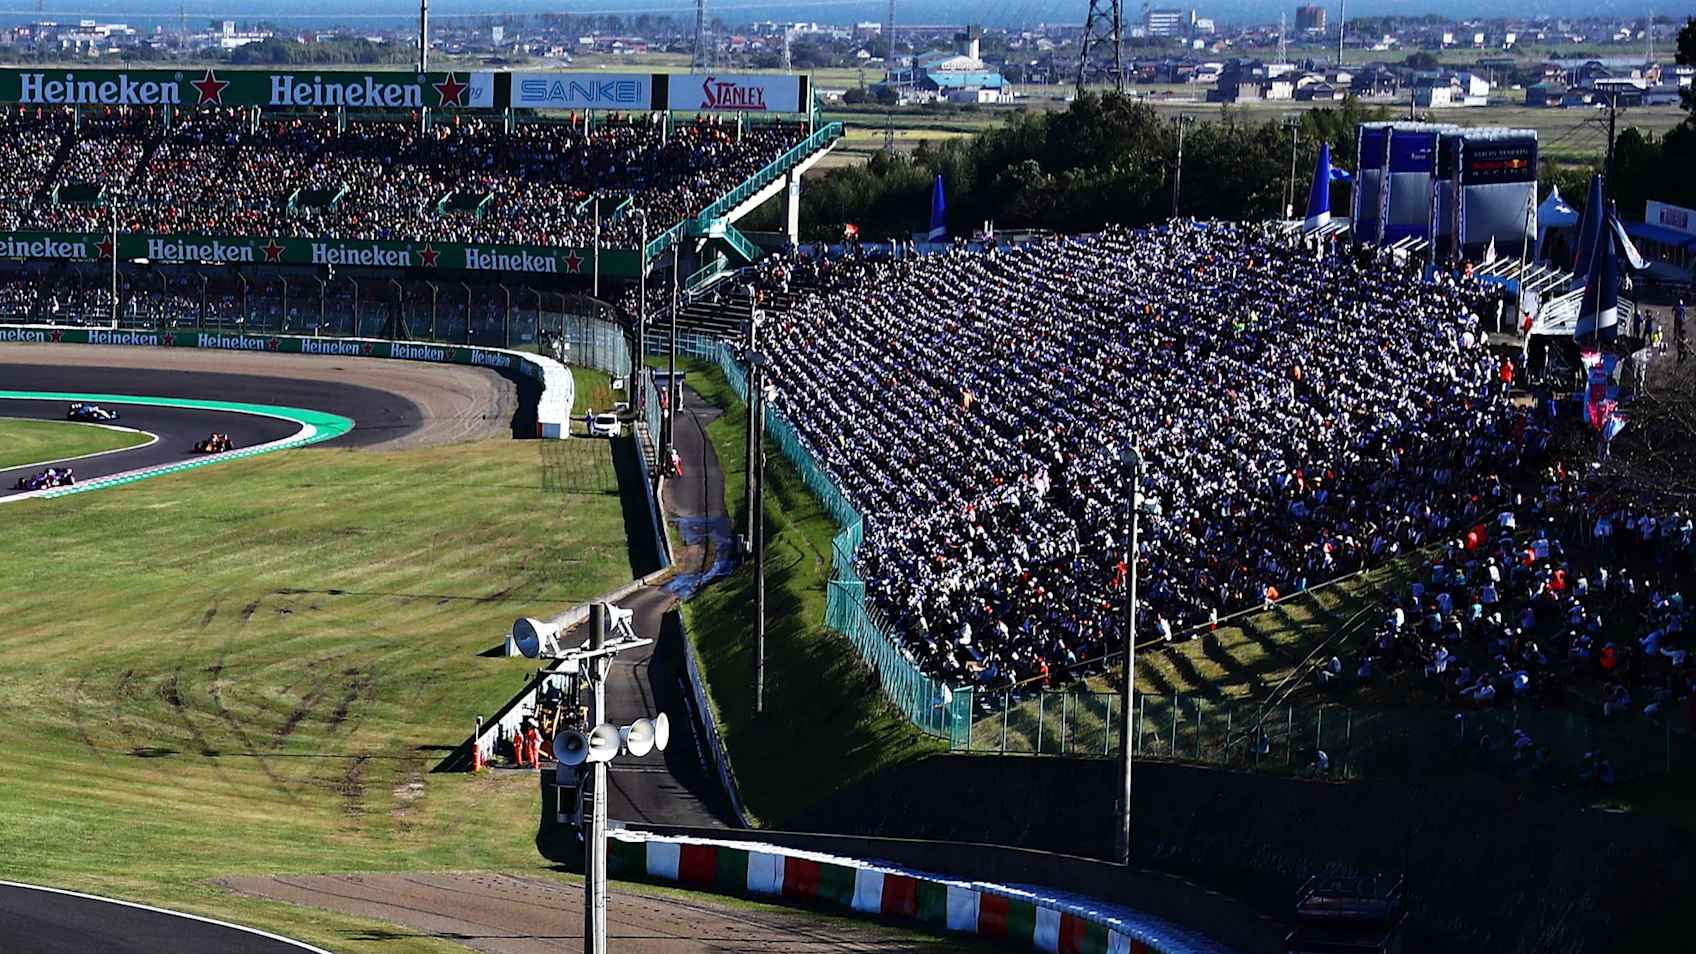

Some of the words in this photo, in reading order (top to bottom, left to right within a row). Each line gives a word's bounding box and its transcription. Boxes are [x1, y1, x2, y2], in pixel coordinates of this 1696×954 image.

[19, 72, 181, 105] Heineken
[269, 75, 424, 107] Heineken
[520, 79, 642, 103] SANKEI
[700, 76, 767, 110] STANLEY
[147, 239, 254, 262] Heineken
[311, 243, 412, 267] Heineken
[464, 248, 557, 273] Heineken
[88, 329, 158, 346] Heineken
[197, 332, 264, 350] Heineken
[301, 338, 360, 355] Heineken
[390, 343, 445, 361] Heineken
